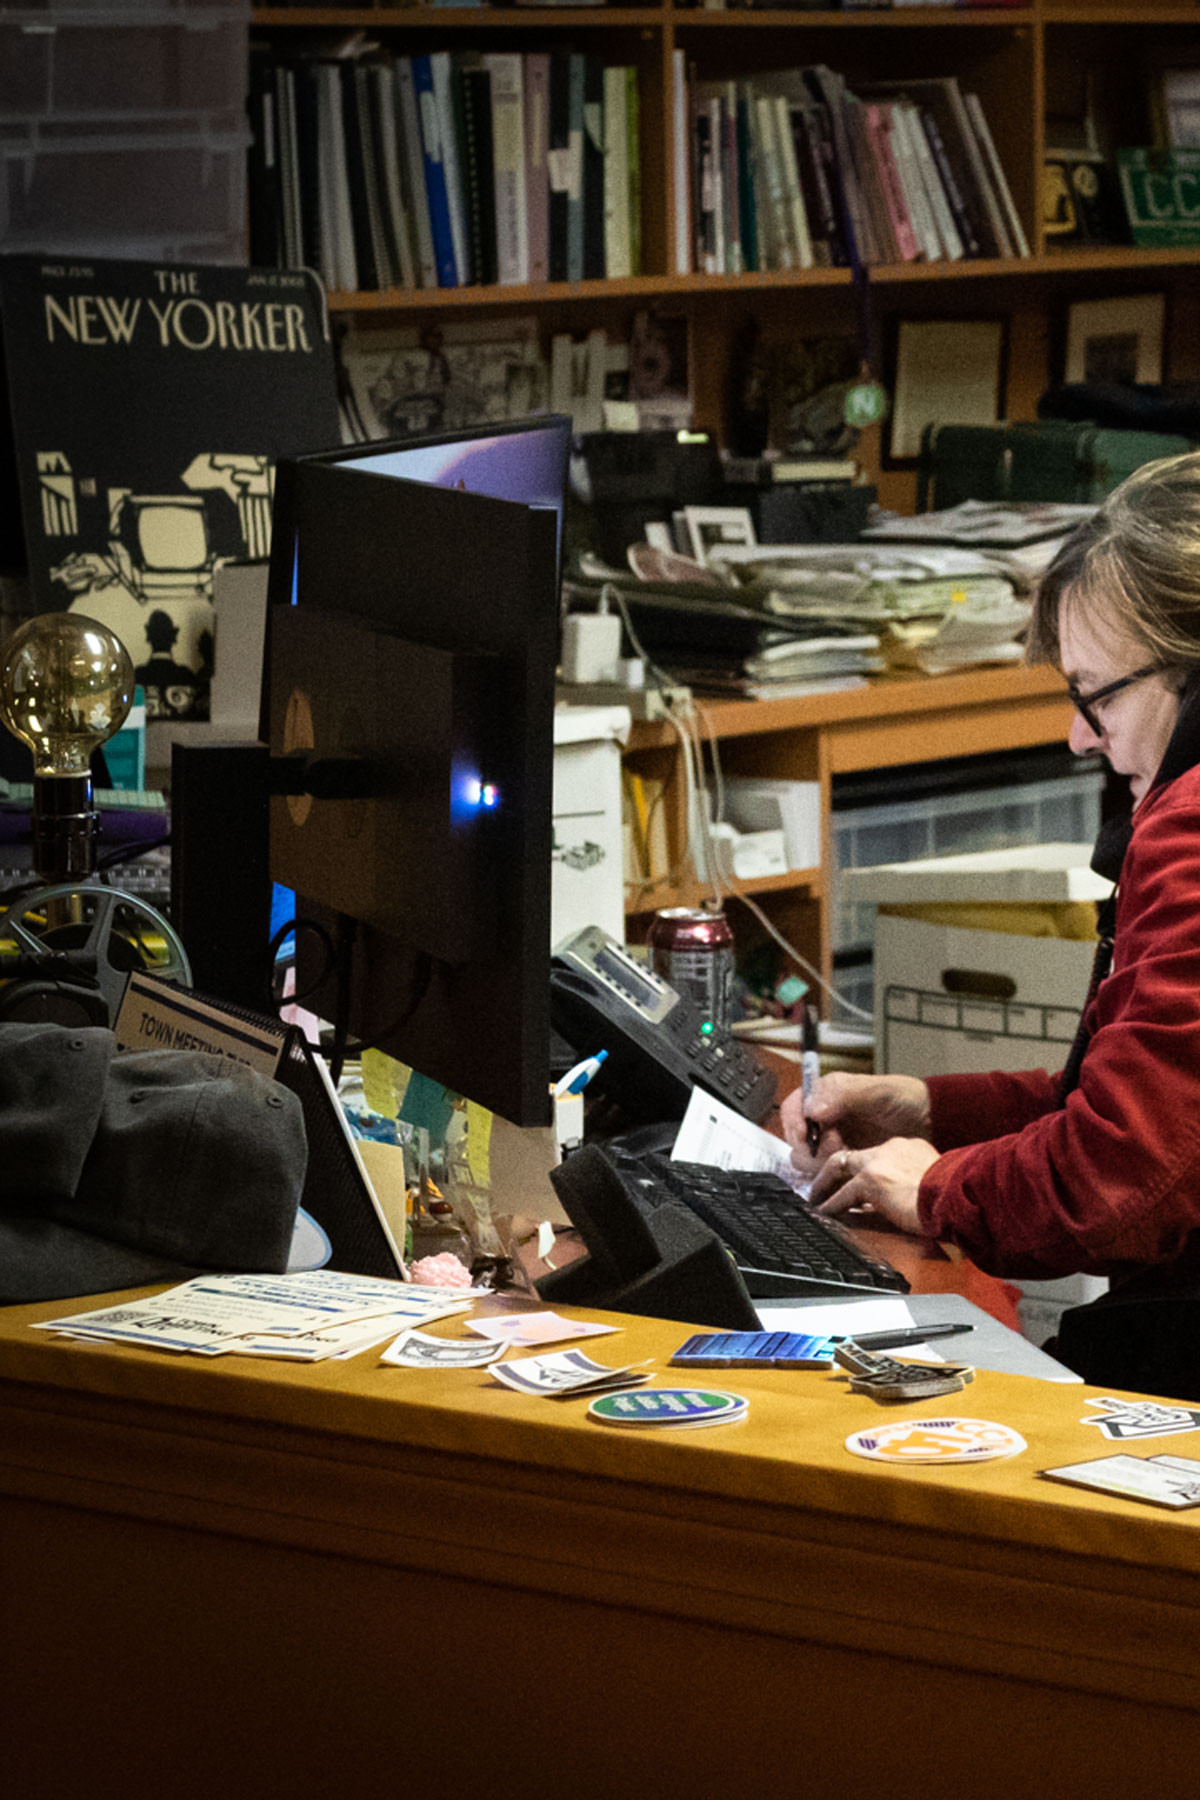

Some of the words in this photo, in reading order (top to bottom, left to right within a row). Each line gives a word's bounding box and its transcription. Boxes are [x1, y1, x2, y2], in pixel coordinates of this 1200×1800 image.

[153, 270, 199, 294] THE
[45, 294, 141, 344] NEW
[149, 299, 312, 353] YORKER
[139, 1012, 174, 1046] TOWN
